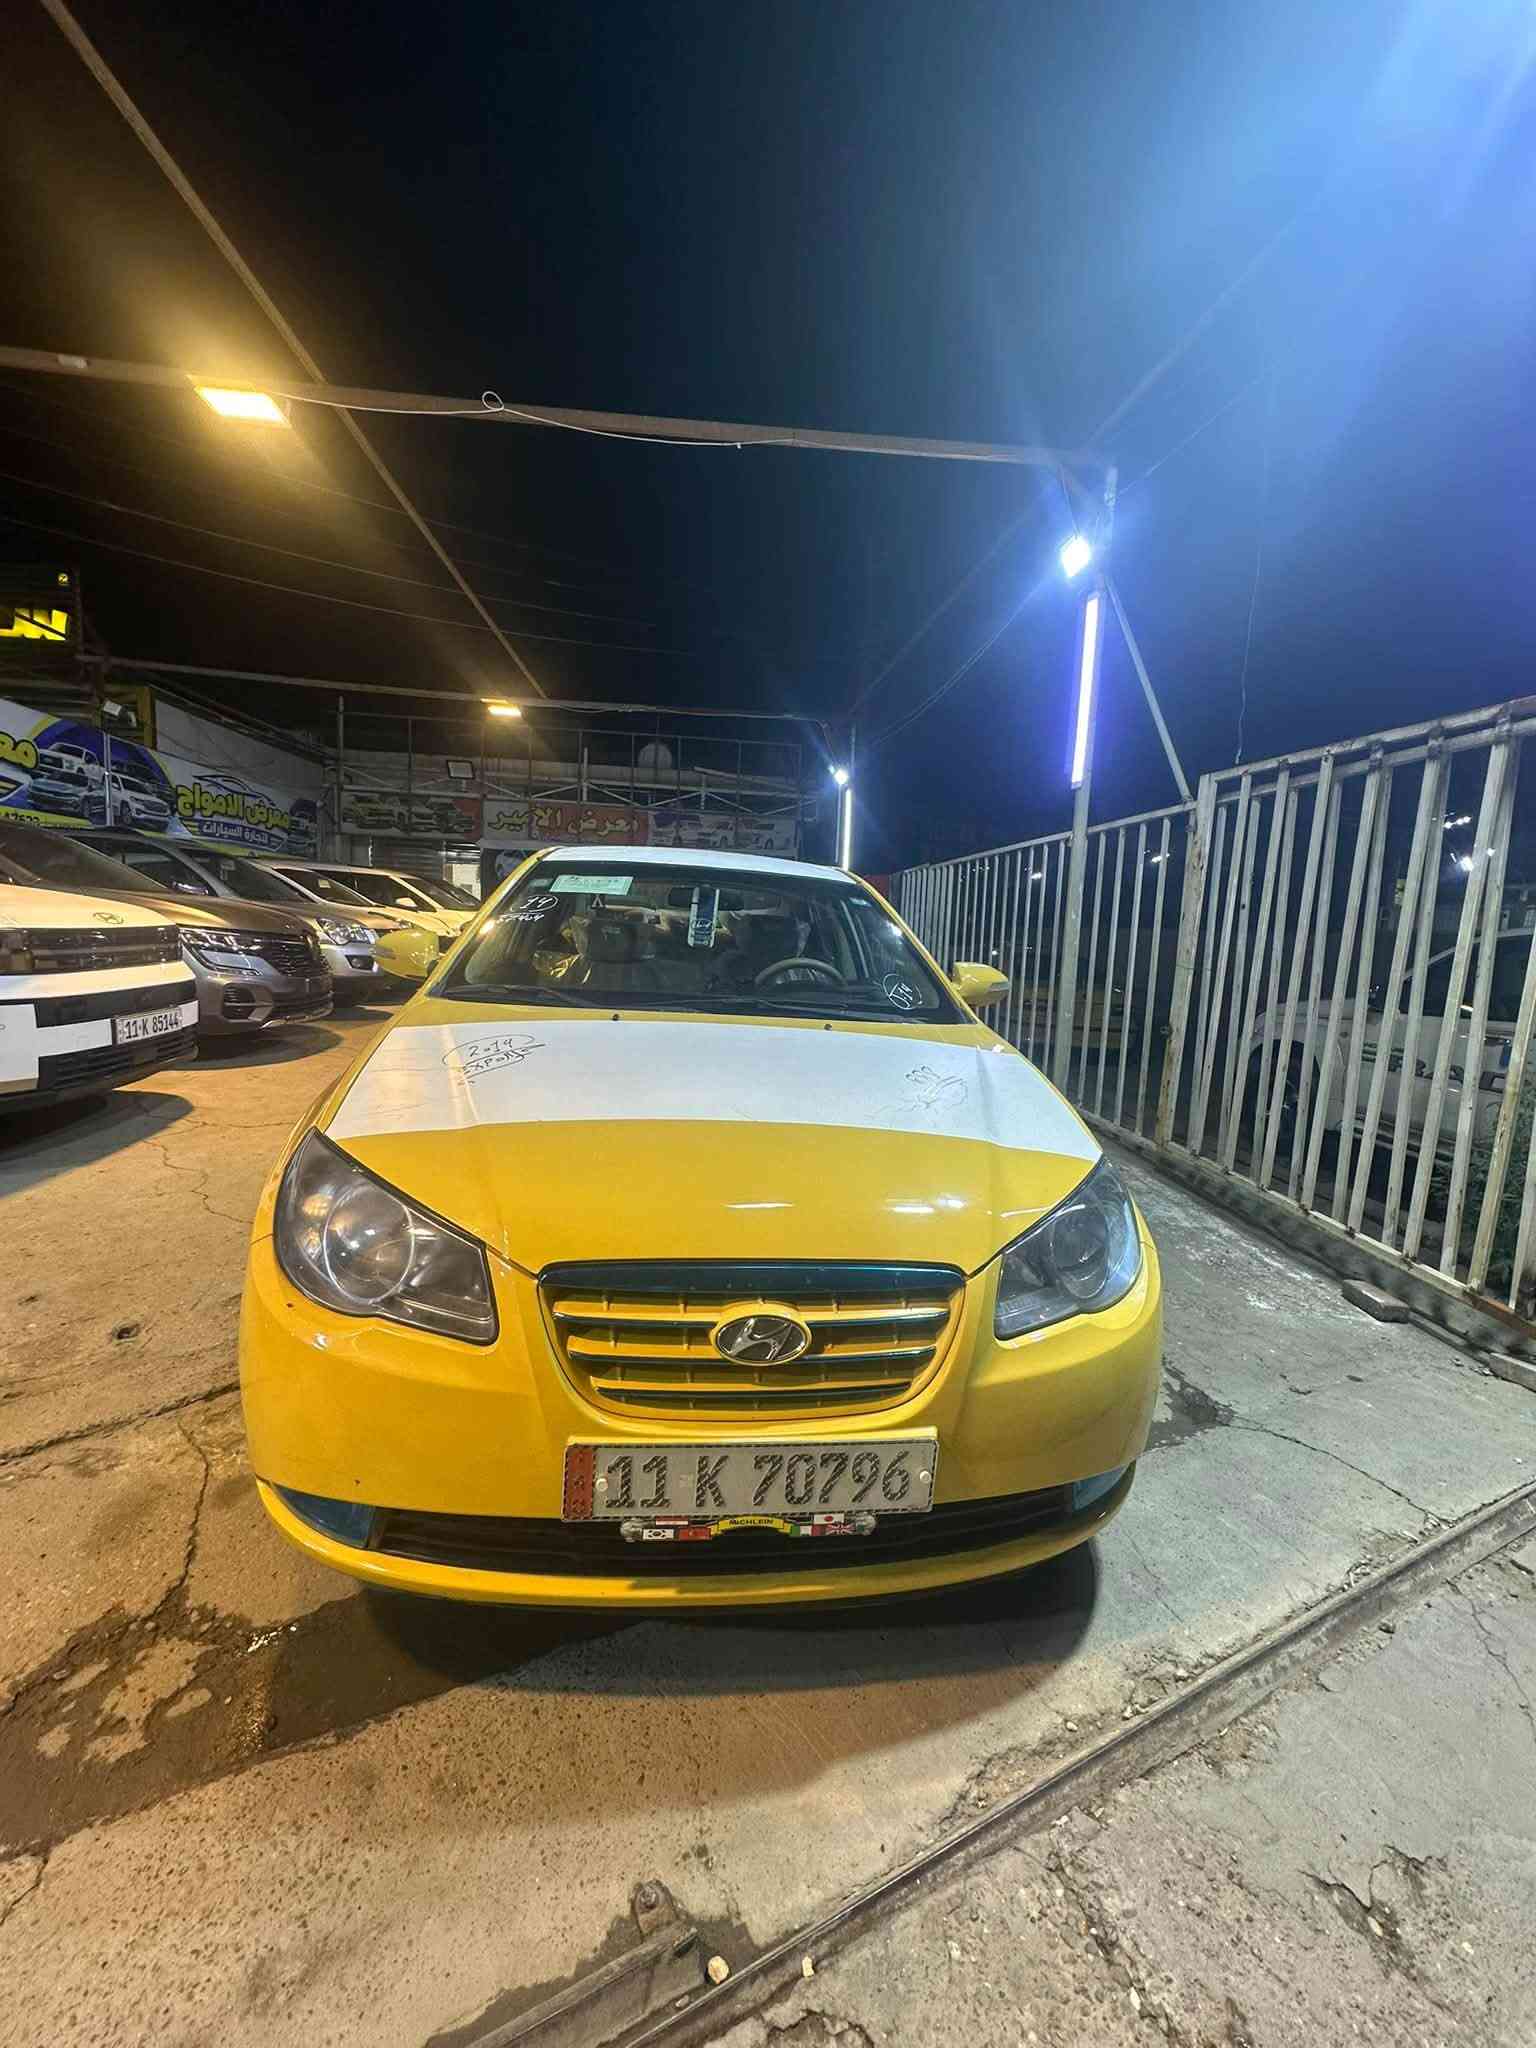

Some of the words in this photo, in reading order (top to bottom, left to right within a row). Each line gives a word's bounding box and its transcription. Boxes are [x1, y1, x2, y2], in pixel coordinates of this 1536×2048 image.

[605, 1455, 671, 1508] 11
[695, 1455, 729, 1508] K
[753, 1450, 909, 1506] 70796
